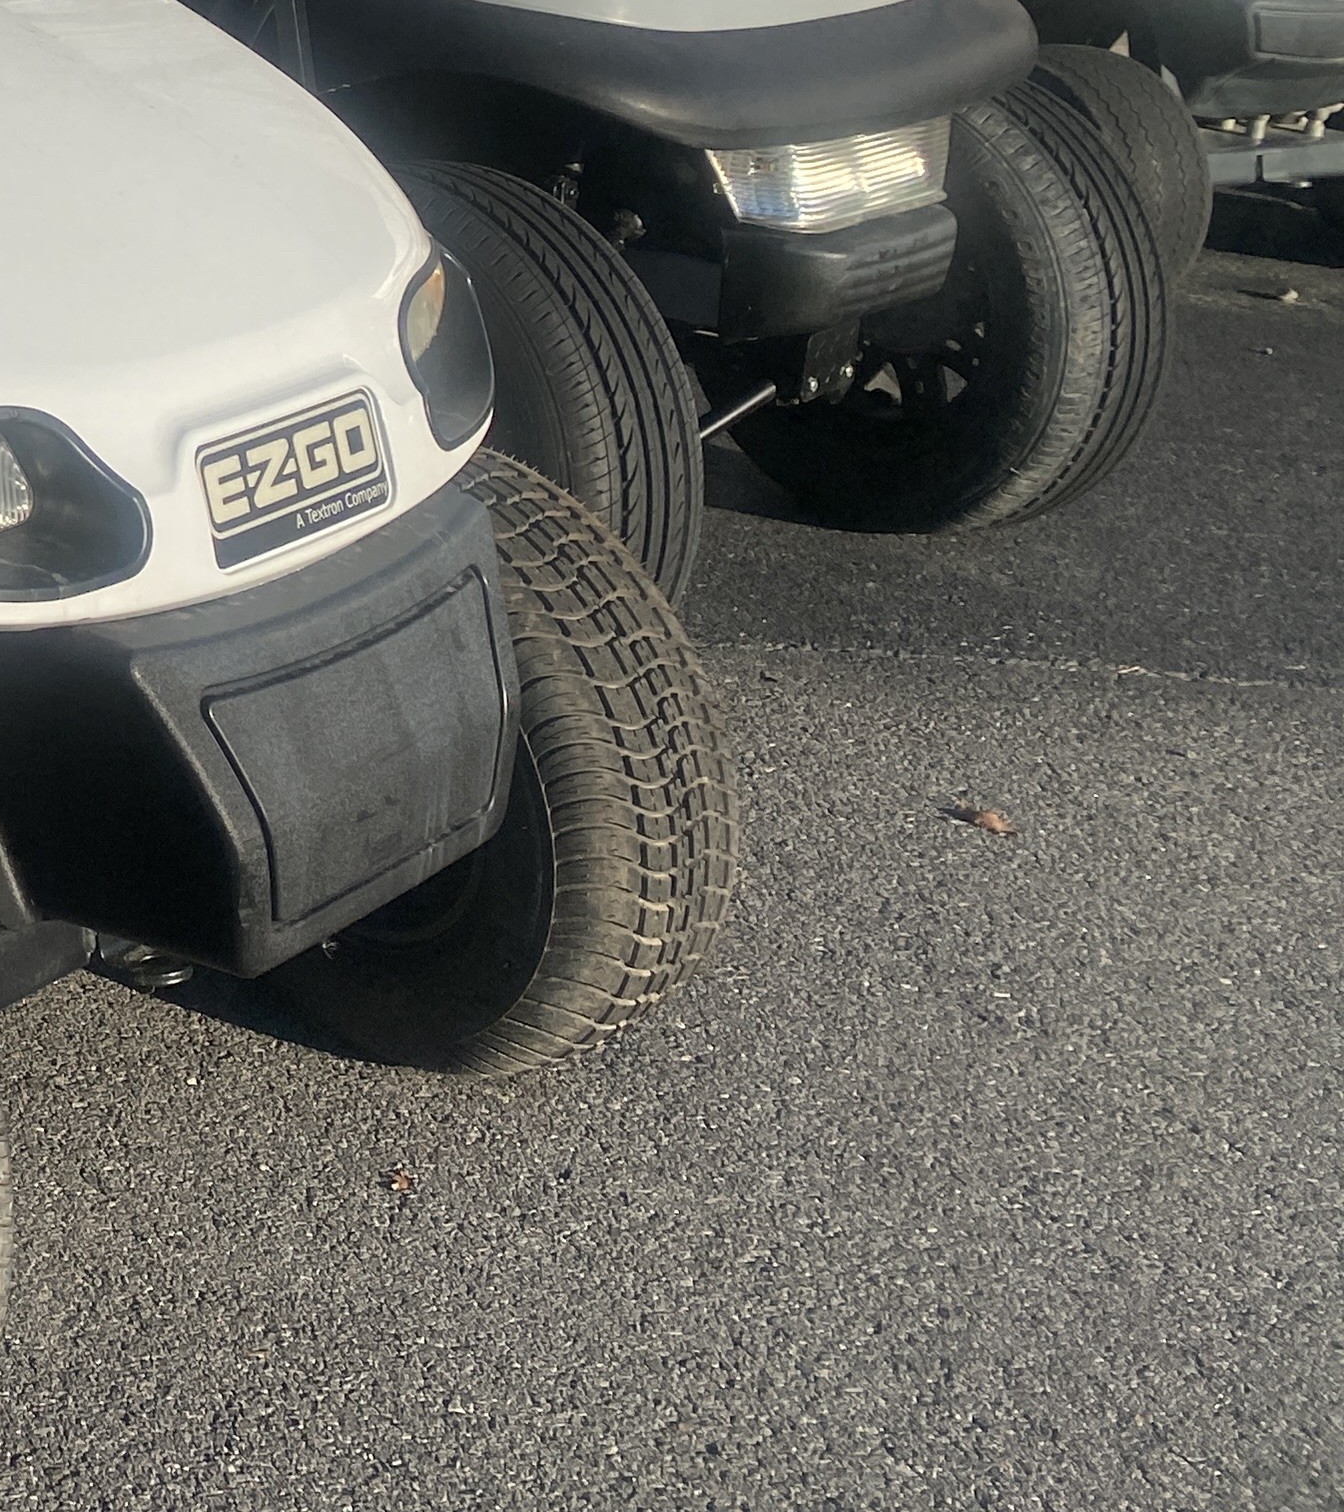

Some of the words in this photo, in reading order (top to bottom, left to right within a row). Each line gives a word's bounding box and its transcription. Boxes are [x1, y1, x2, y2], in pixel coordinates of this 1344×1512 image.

[296, 513, 305, 529] A
[305, 499, 345, 524] Textron
[345, 481, 389, 508] Company
